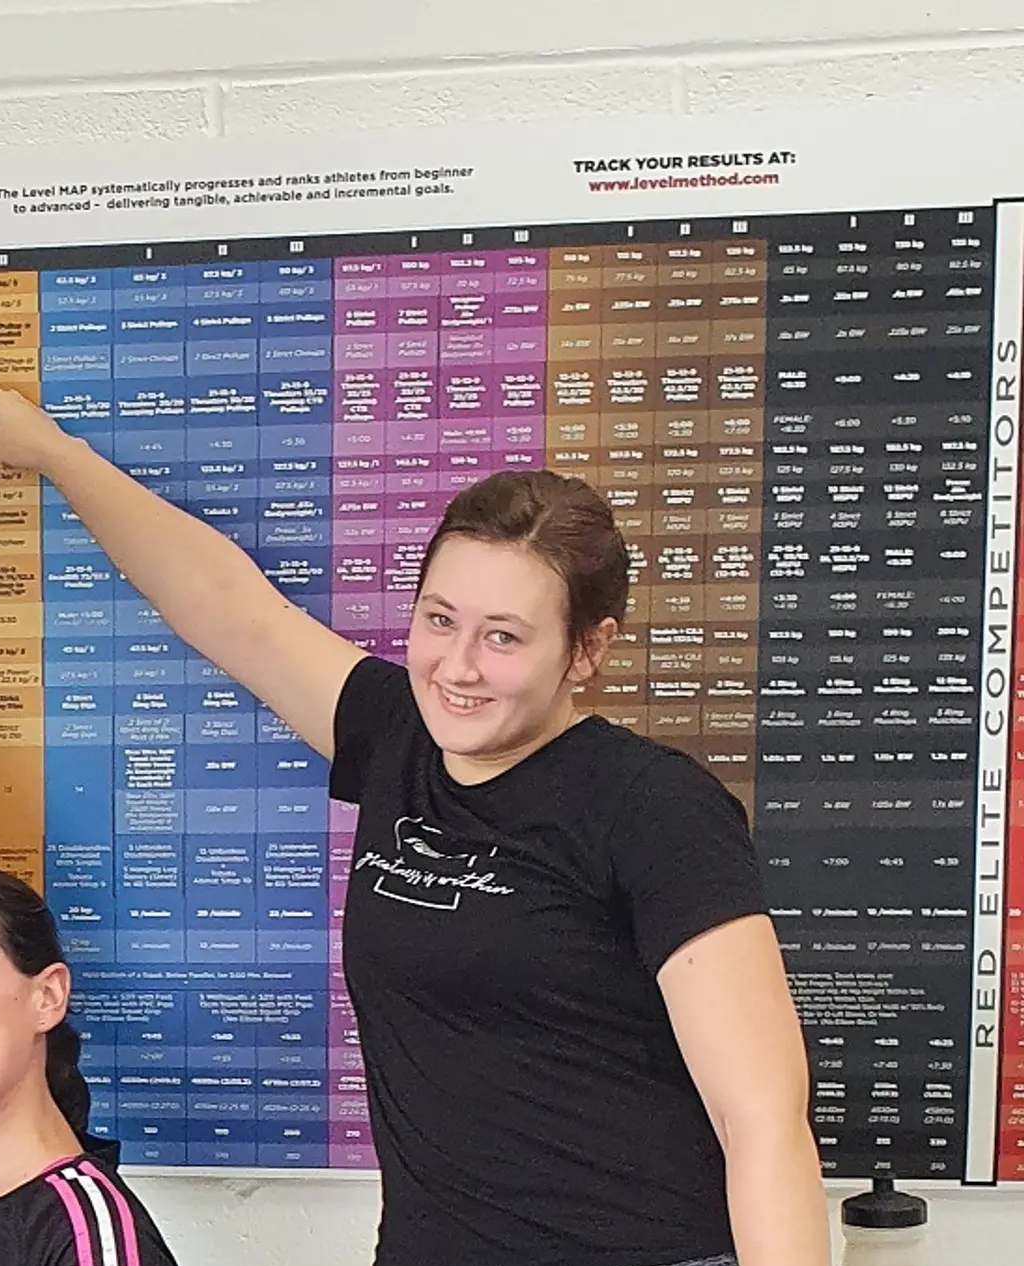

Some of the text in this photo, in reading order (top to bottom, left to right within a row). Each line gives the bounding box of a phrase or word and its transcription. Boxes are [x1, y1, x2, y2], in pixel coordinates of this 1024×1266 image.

[574, 152, 796, 173] TRACK YOUR RESULTS AT:
[23, 187, 55, 198] Level
[60, 185, 87, 195] MAP
[92, 180, 181, 196] systematically
[185, 178, 254, 190] progresses
[258, 175, 281, 186] and
[286, 174, 320, 185] ranks
[324, 172, 375, 183] athletes
[379, 170, 410, 181] from
[415, 167, 473, 179] beginner
[588, 173, 779, 192] www.levelmethod.com
[13, 203, 26, 213] to
[30, 200, 90, 212] advanced
[107, 197, 169, 209] delivering
[174, 194, 230, 206] tangible,
[234, 189, 302, 202] achievable
[306, 188, 330, 199] and
[334, 184, 410, 198] incremental
[415, 183, 454, 197] goals.
[975, 340, 1018, 1048] RED ELITE COMPETITORS
